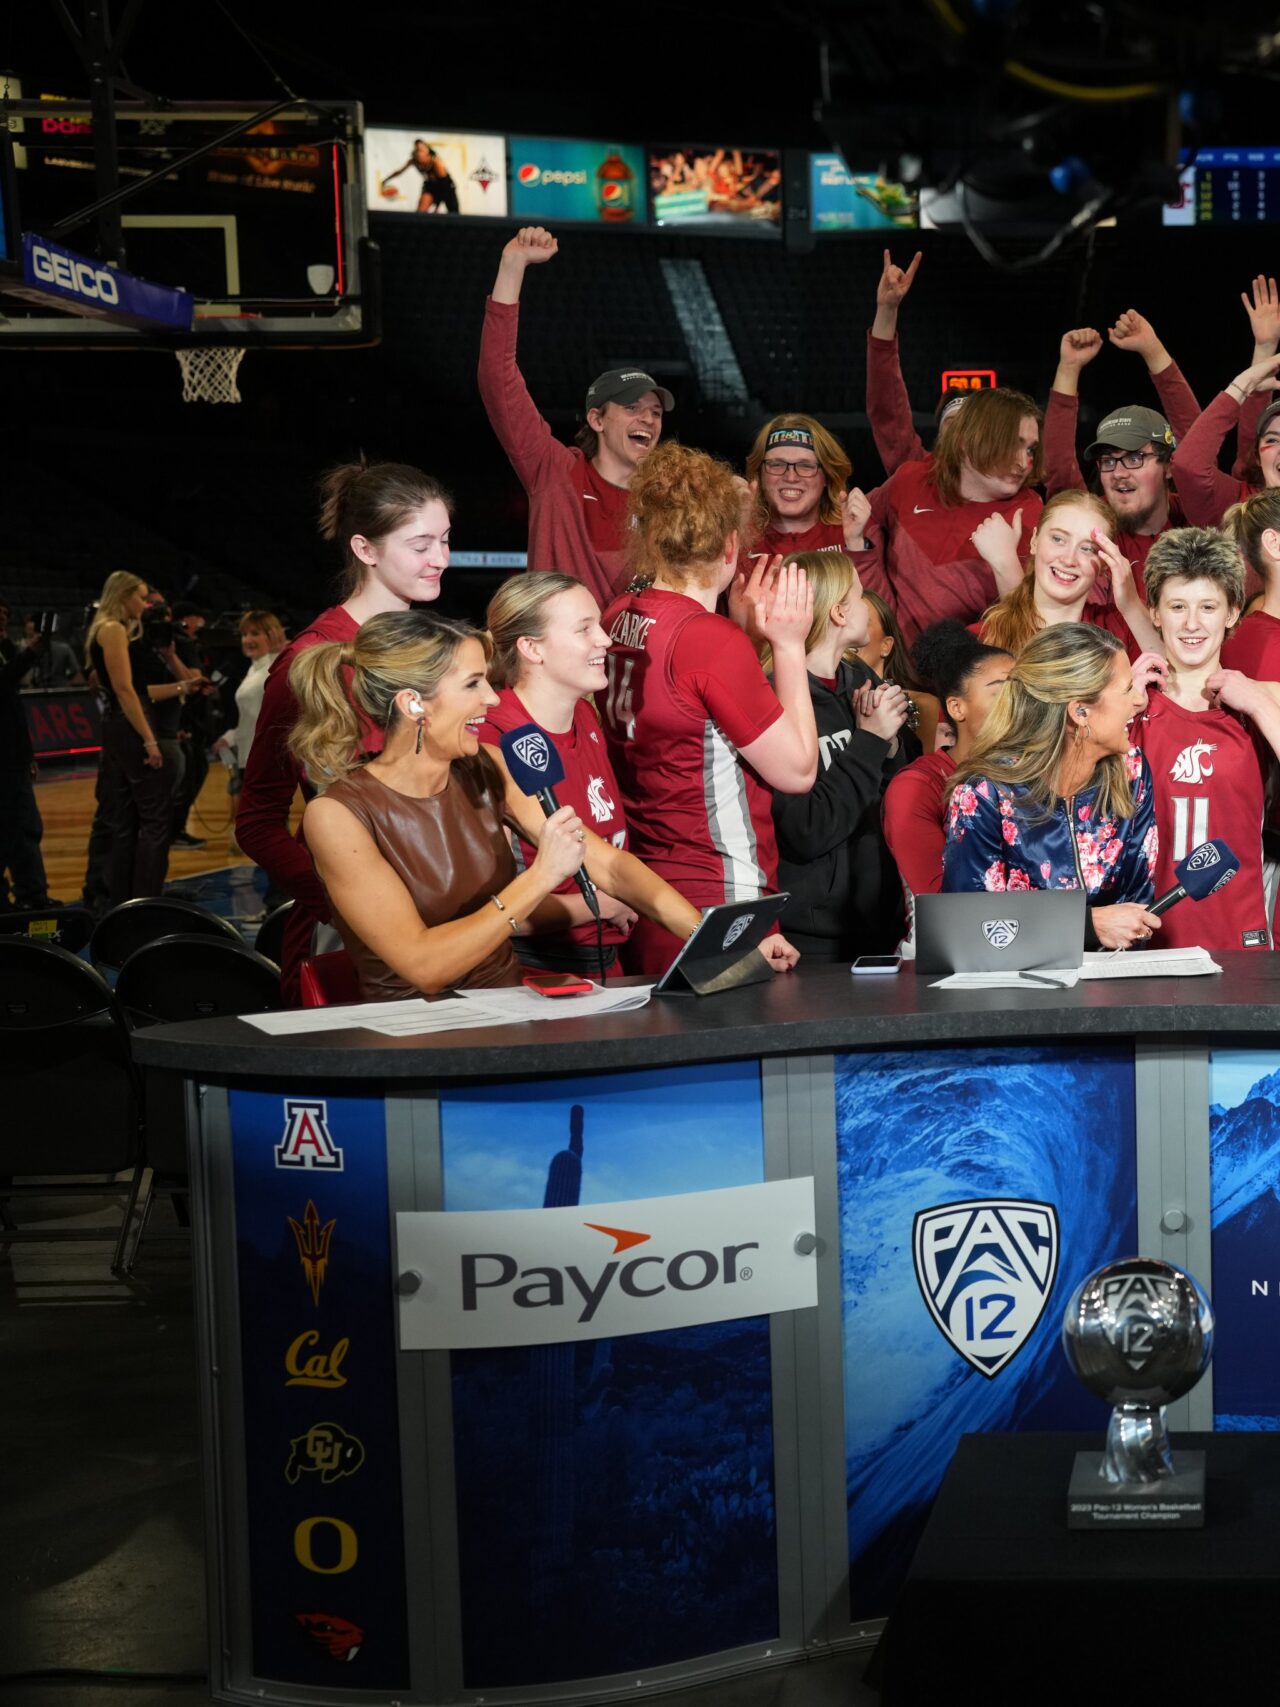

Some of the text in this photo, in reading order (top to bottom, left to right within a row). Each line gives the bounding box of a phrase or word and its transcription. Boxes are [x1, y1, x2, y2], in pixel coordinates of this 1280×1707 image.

[541, 169, 587, 186] pepsi
[32, 245, 119, 305] GEICO
[609, 609, 656, 650] CLARKE
[605, 652, 636, 741] 14
[531, 752, 546, 766] 12
[1171, 796, 1209, 862] 11
[984, 921, 1018, 940] PAC
[994, 935, 1008, 944] 12
[274, 1098, 344, 1172] A
[921, 1209, 1050, 1300] PAC
[1103, 1275, 1179, 1310] PAC
[965, 1293, 1017, 1341] 12
[1122, 1323, 1153, 1353] 12
[284, 1330, 349, 1389] Cal
[307, 1429, 342, 1470] CU
[294, 1517, 358, 1574] O
